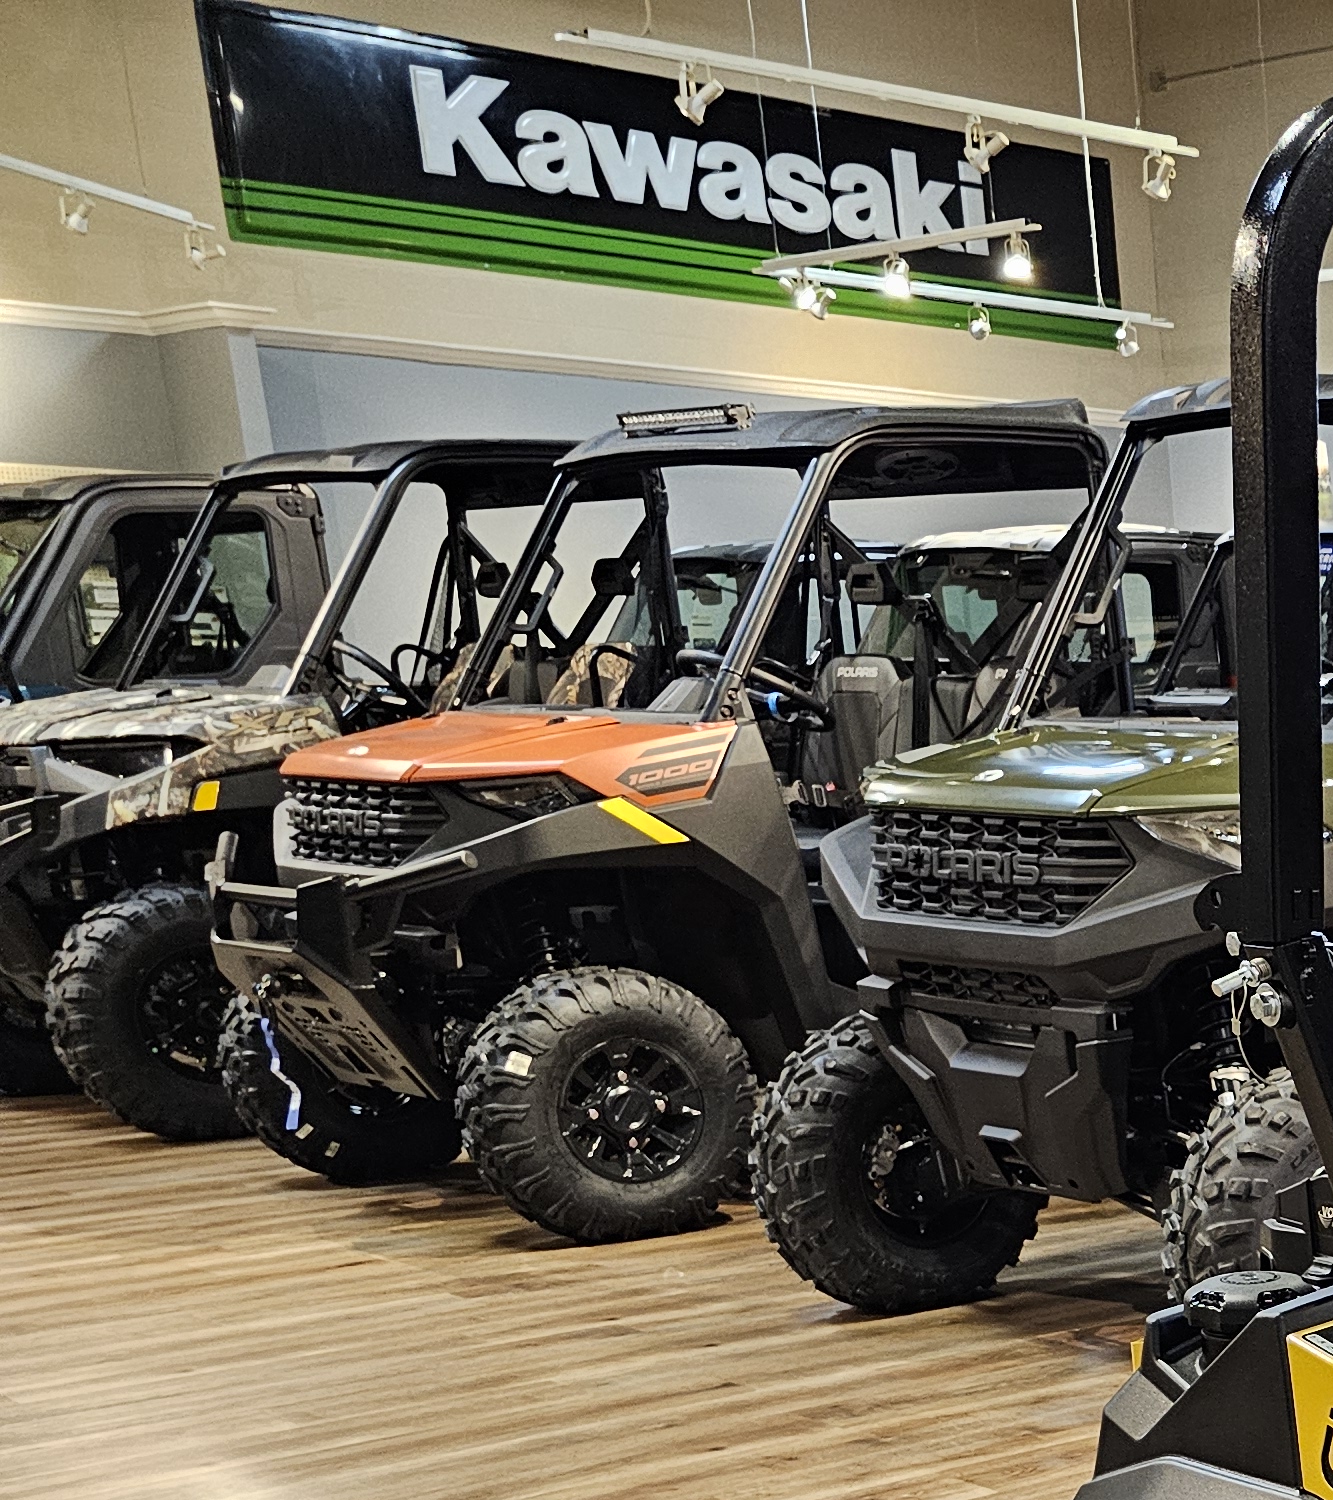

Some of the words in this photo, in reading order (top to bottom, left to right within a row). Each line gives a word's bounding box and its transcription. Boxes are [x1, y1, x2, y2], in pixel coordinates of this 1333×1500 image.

[409, 65, 990, 256] Kawasaki
[837, 666, 879, 678] POLARIS
[628, 759, 714, 786] 1000
[288, 807, 383, 837] POLARIS
[886, 843, 1040, 886] POLARIS
